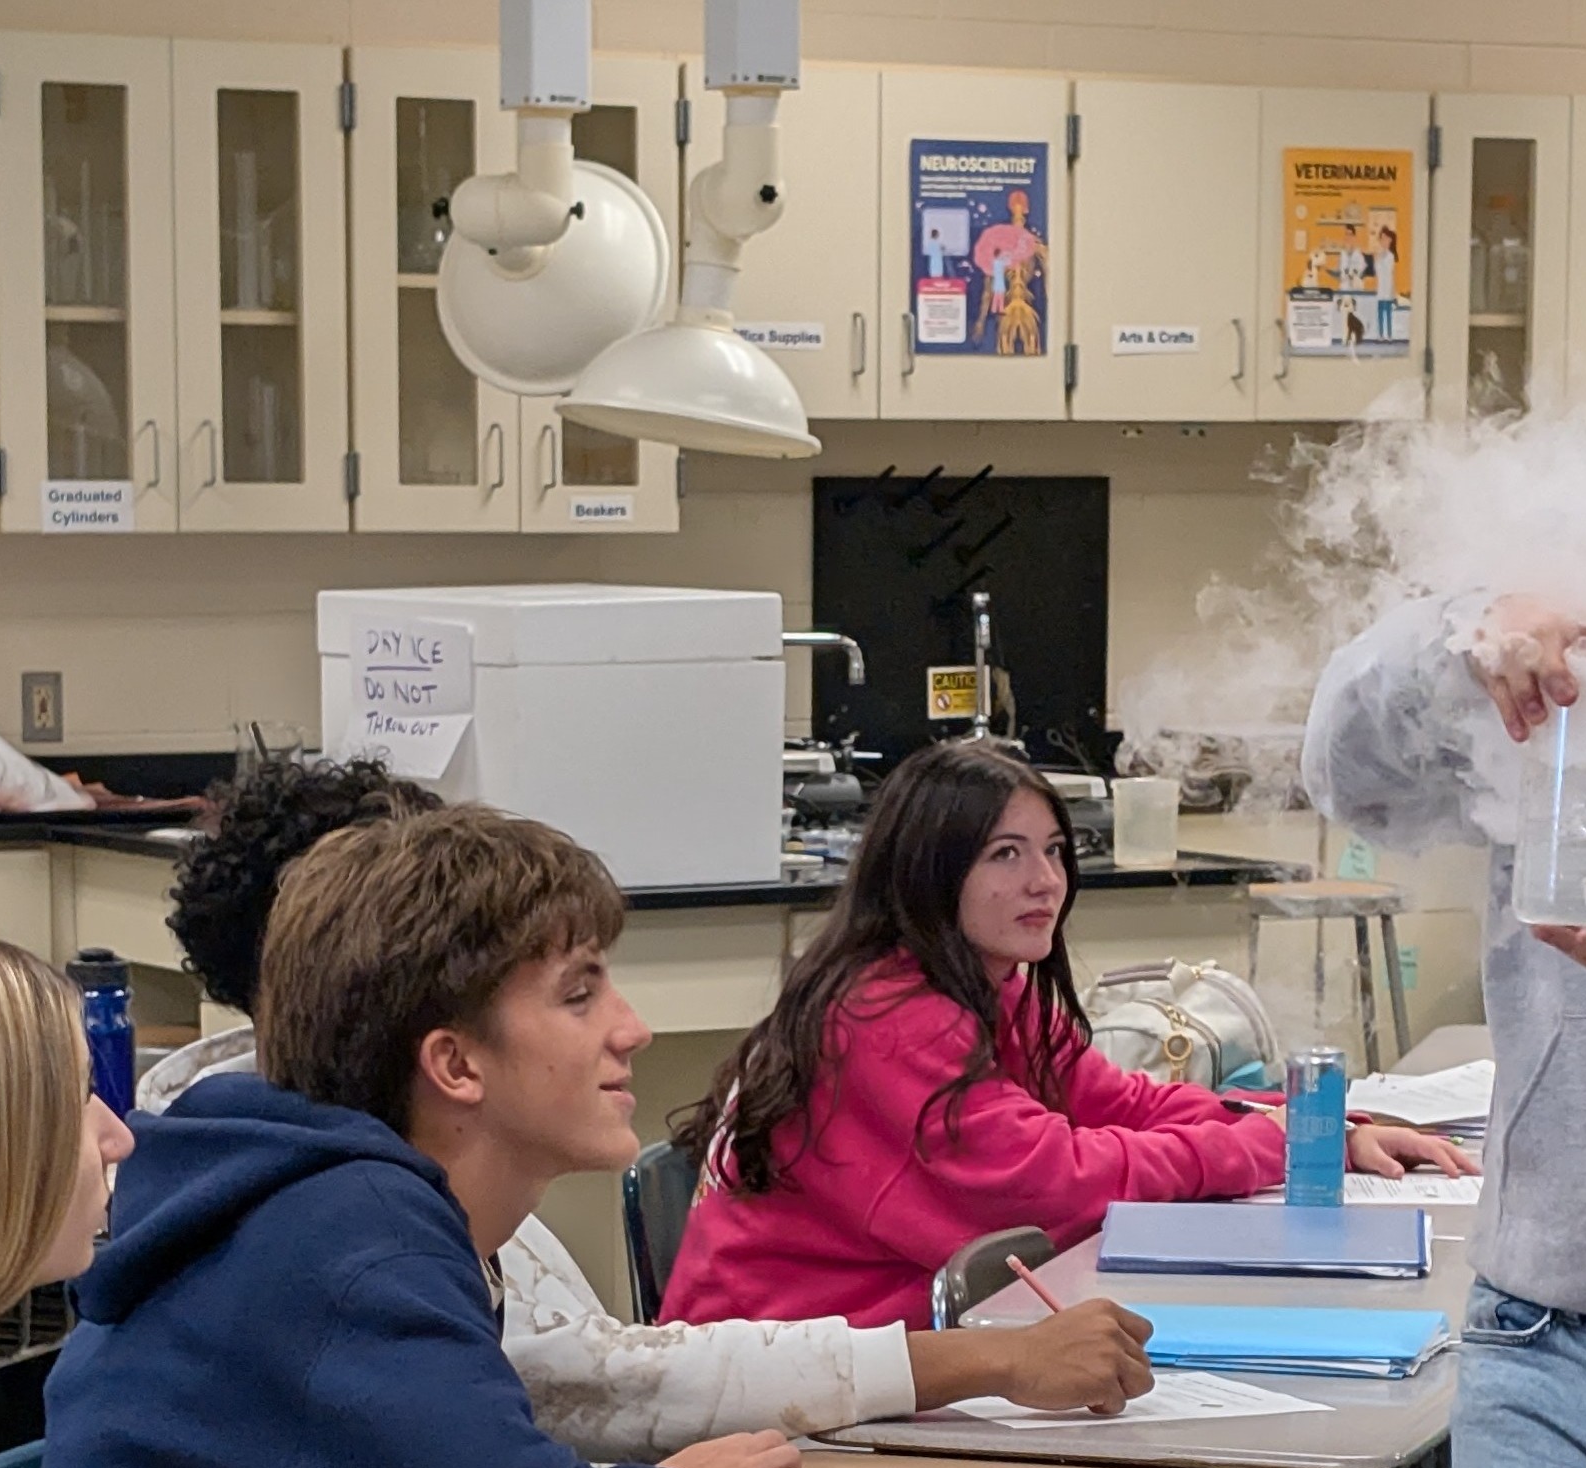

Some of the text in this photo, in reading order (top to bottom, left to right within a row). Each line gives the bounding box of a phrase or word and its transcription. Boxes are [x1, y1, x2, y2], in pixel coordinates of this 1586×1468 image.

[920, 155, 1036, 174] NEUROSCIENTIST
[1294, 163, 1398, 181] VETERINARIAN
[734, 328, 821, 345] ffice Supplies
[1119, 331, 1194, 344] Arts & Crafts
[48, 490, 122, 503] Graduated
[52, 510, 119, 525] Cylinders
[576, 504, 626, 517] Beakers
[366, 630, 444, 664] DRY ICE
[934, 674, 978, 690] CAUTIO
[364, 677, 437, 704] DO NOT
[411, 722, 440, 736] OUT
